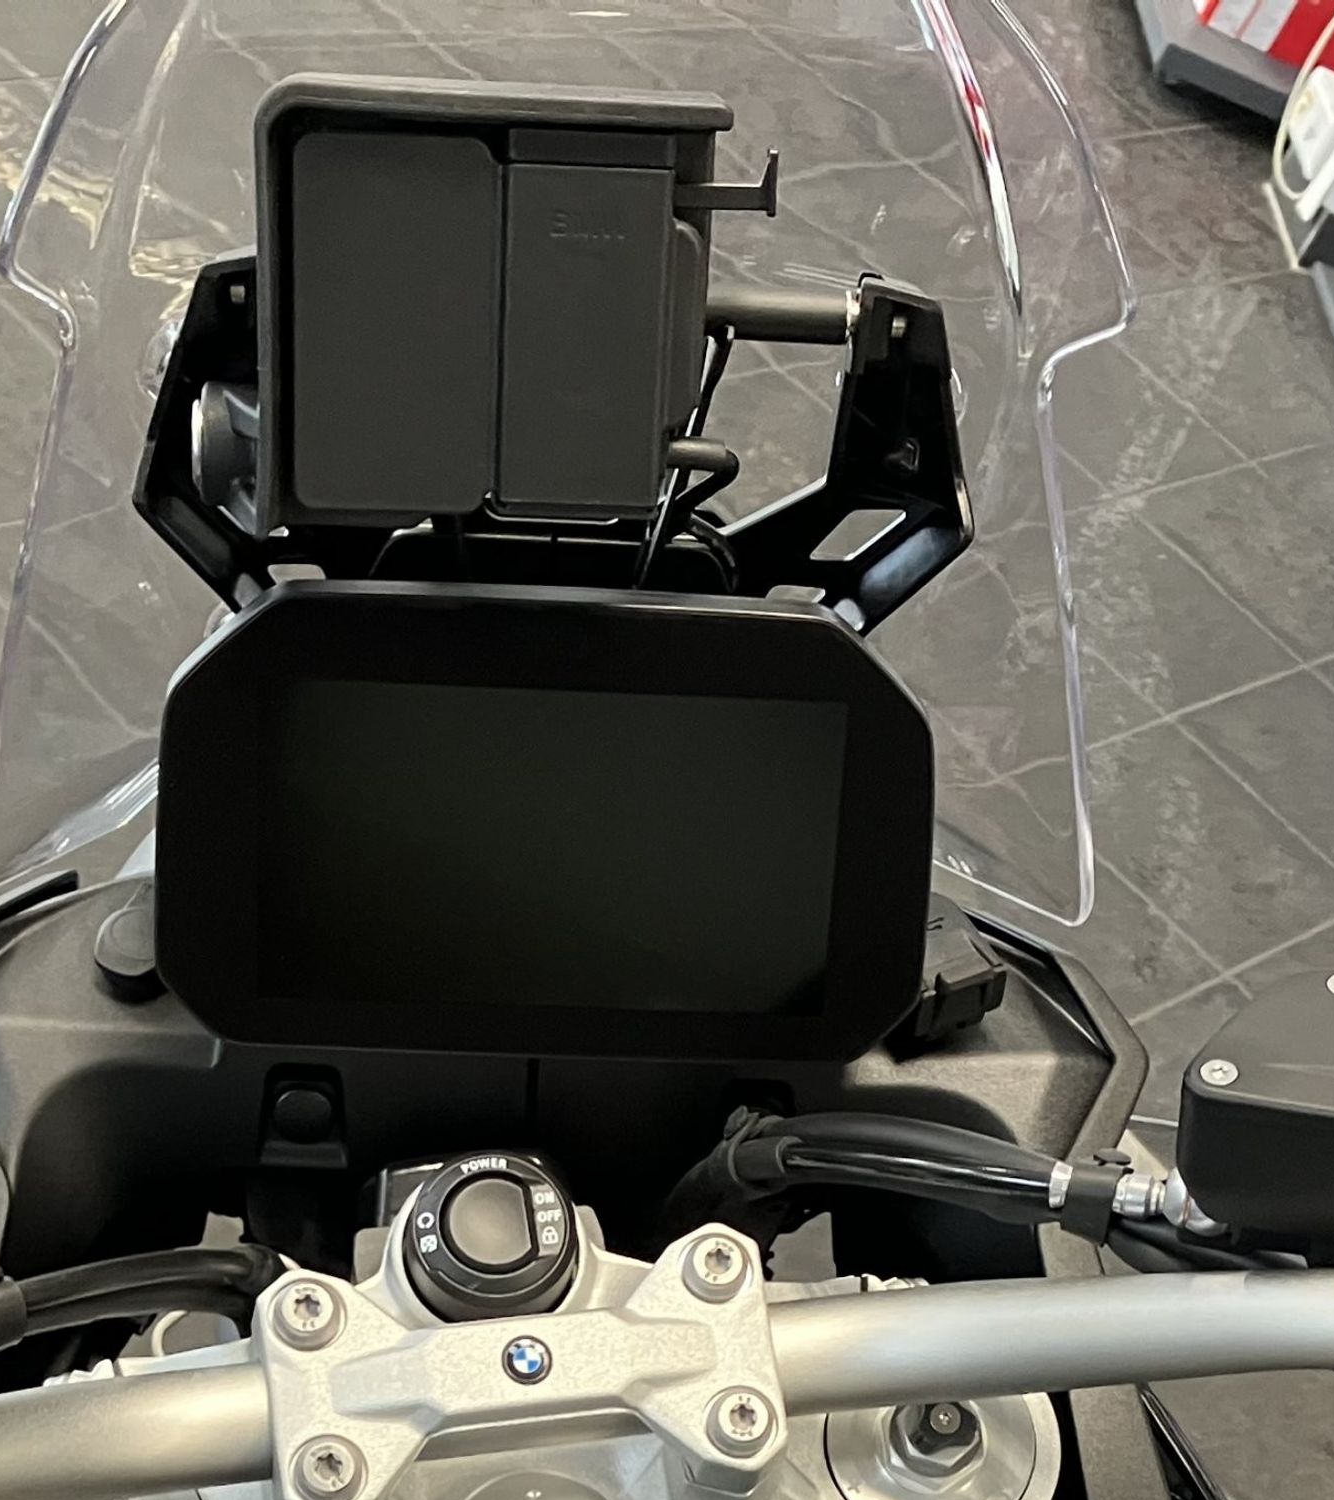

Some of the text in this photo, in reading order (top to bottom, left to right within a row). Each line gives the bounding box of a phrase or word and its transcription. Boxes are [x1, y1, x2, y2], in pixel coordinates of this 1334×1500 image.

[460, 1157, 508, 1174] POWER
[534, 1191, 555, 1205] ON
[537, 1209, 563, 1223] OFF
